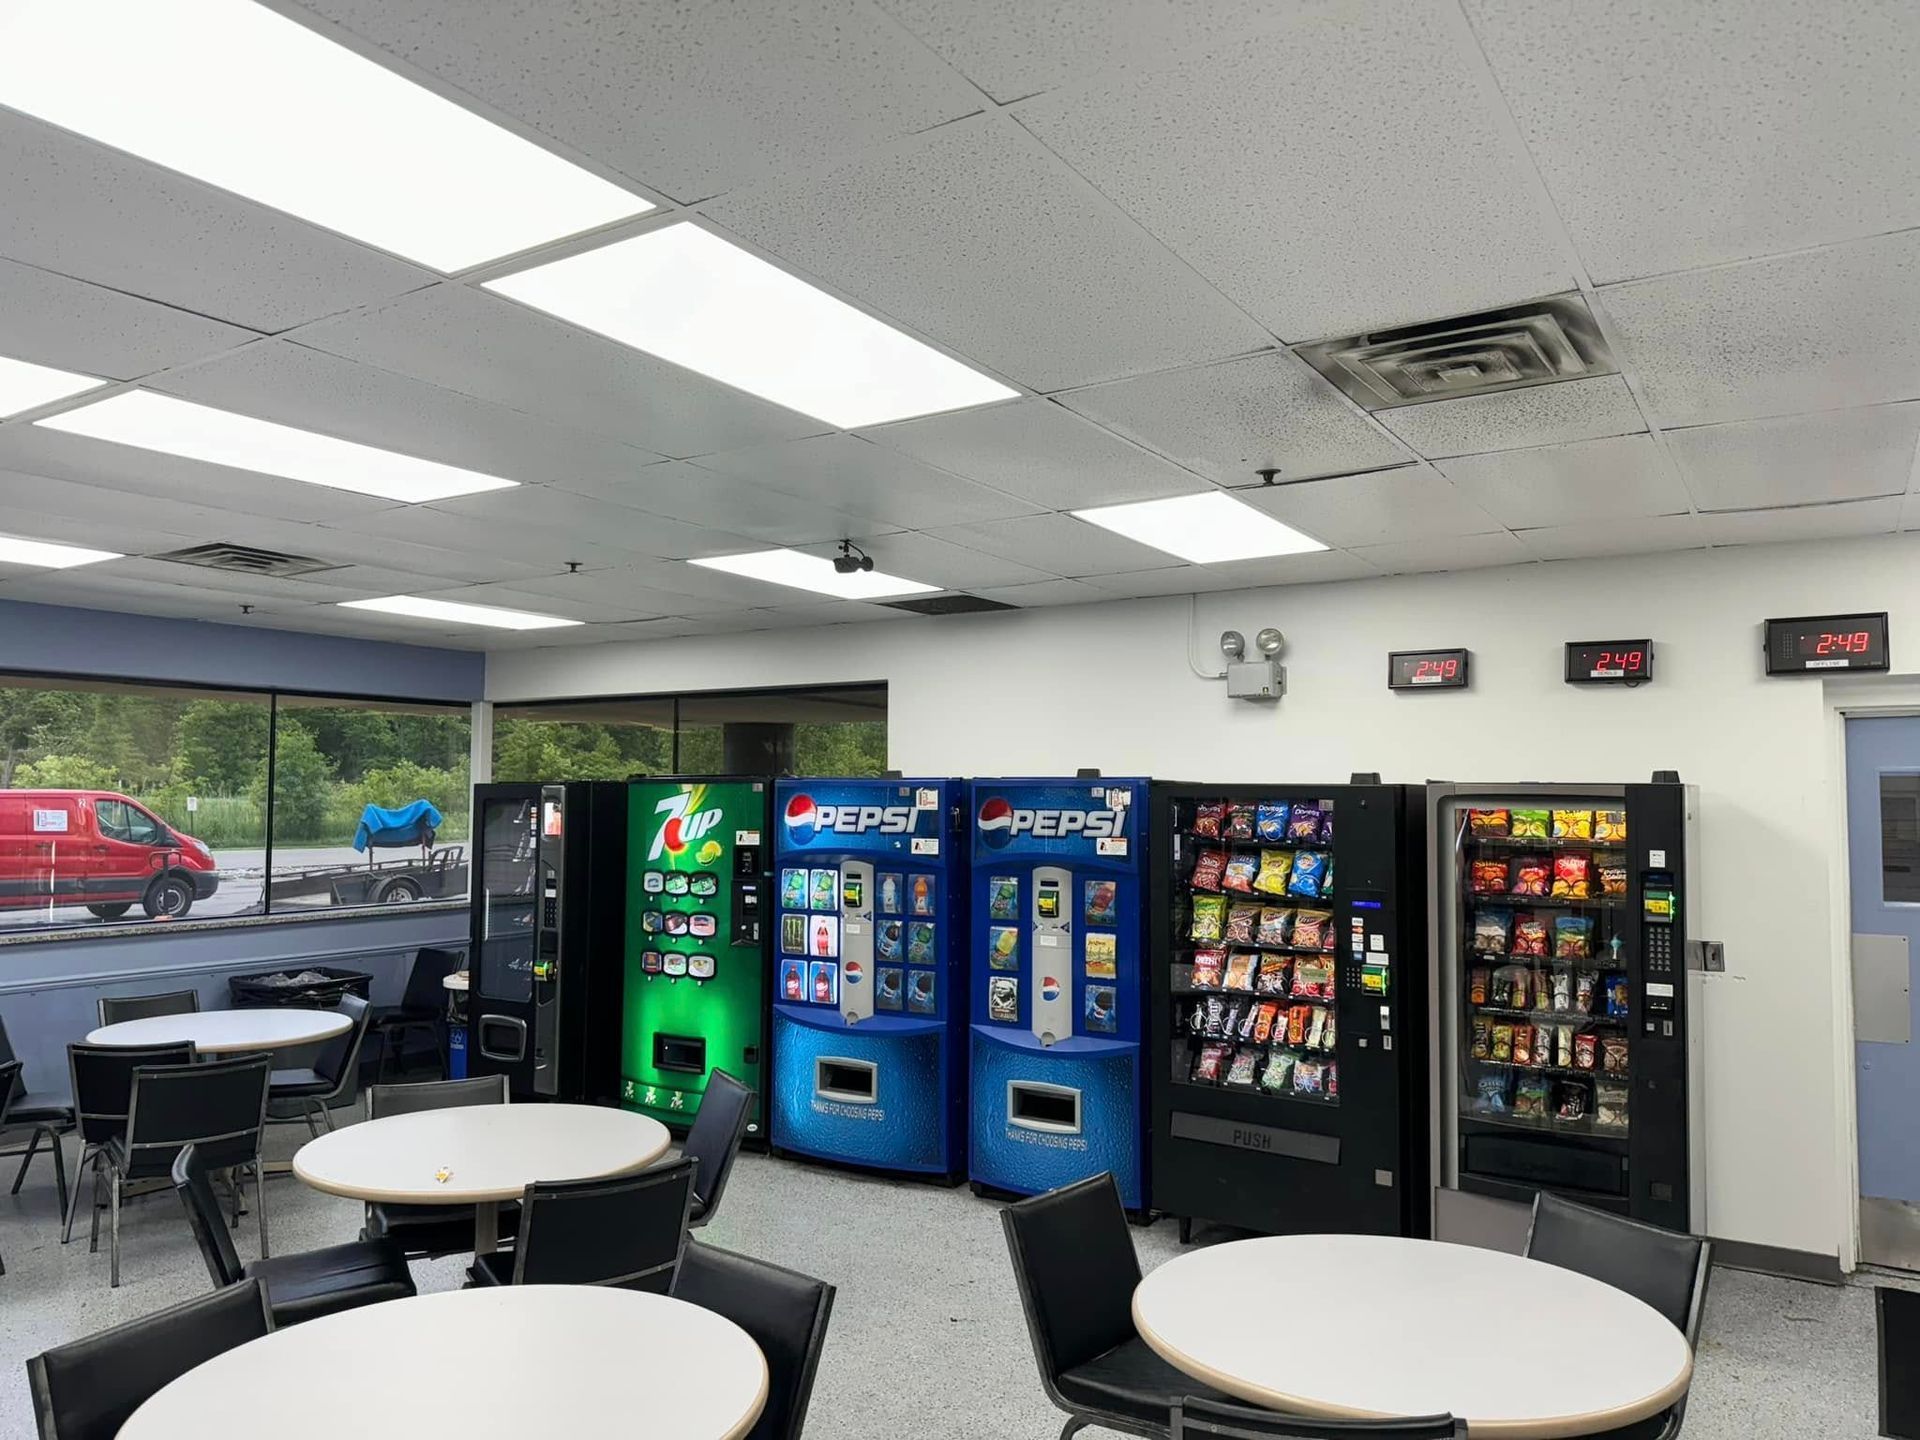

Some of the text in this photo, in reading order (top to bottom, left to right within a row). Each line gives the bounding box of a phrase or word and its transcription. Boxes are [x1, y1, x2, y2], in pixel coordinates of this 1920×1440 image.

[1816, 631, 1870, 654] 2:49
[1258, 804, 1284, 813] Doritos
[1294, 808, 1320, 817] Doritos
[813, 806, 918, 833] PEPSI
[1009, 809, 1127, 838] PEPSI
[829, 1103, 840, 1115] FOR
[867, 1108, 885, 1121] PEPSI
[1025, 1131, 1037, 1144] FOR
[1068, 1138, 1088, 1152] PEPSI
[1232, 1129, 1272, 1149] PUSH
